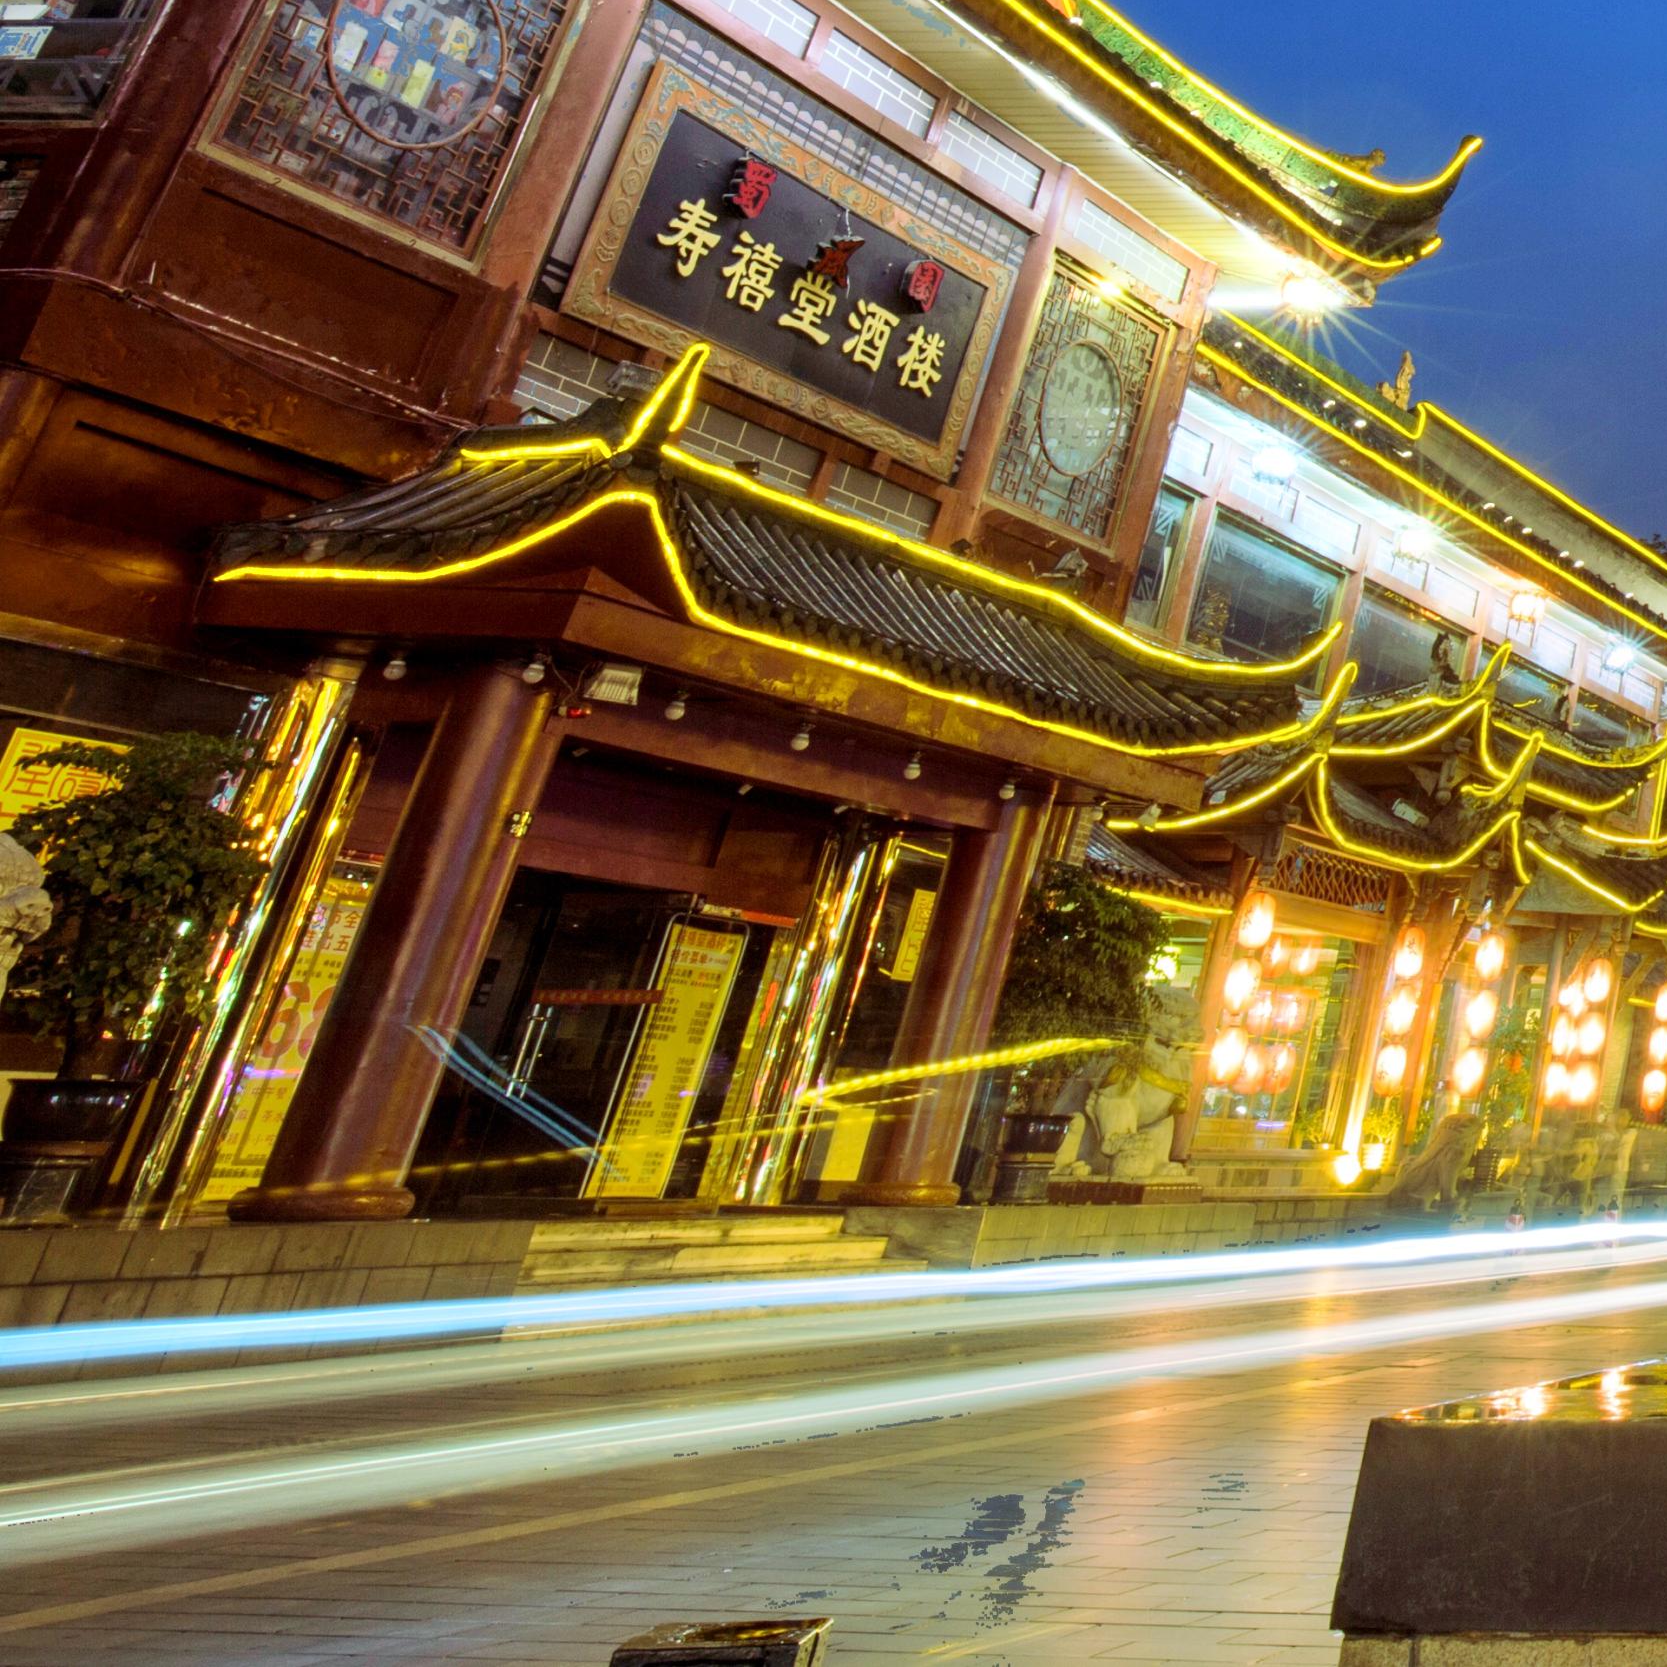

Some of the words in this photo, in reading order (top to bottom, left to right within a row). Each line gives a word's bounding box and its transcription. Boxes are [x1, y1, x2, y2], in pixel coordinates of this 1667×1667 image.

[656, 198, 947, 397] 寿禧堂酒楼
